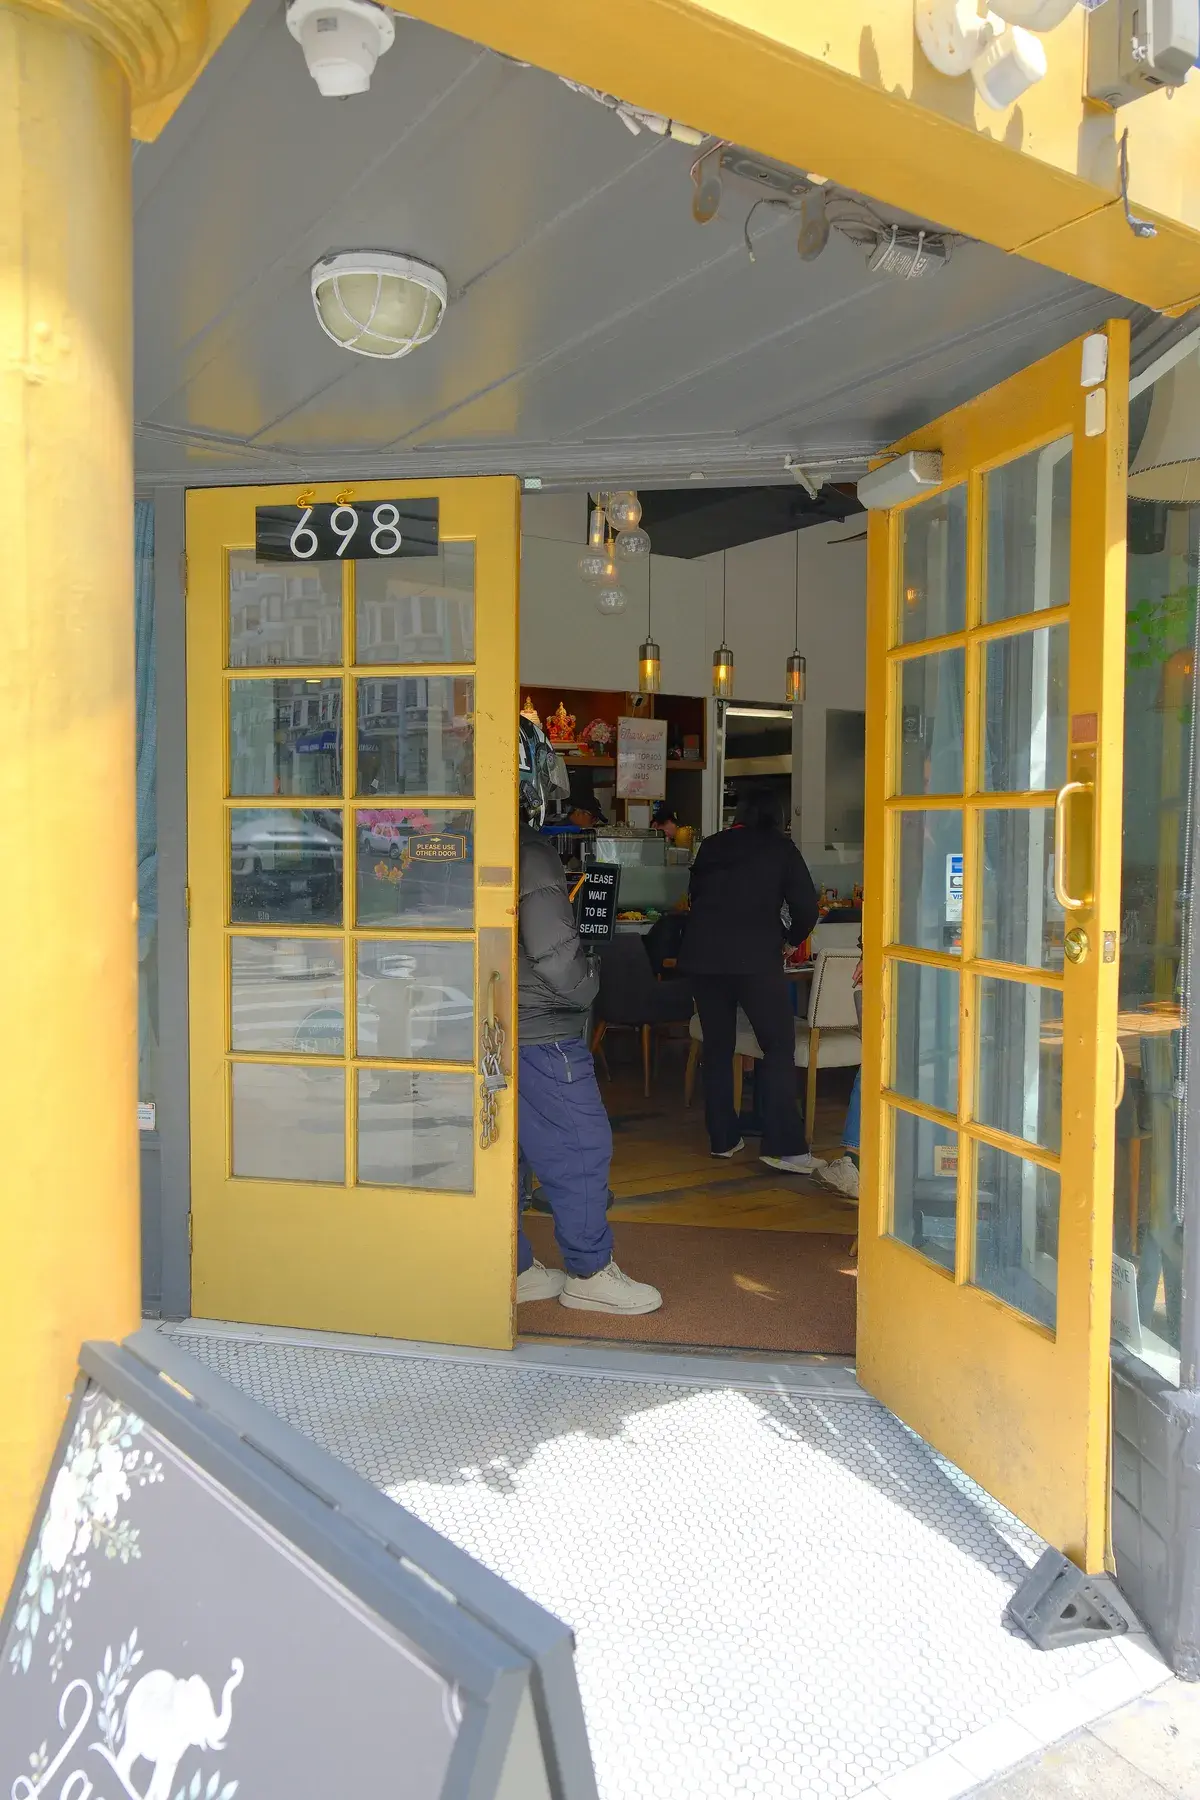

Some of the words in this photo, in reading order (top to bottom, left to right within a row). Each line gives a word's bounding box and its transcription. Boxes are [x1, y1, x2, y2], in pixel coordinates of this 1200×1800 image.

[290, 503, 402, 559] 698
[585, 873, 613, 884] PLEASE
[588, 890, 607, 901] WAIT
[585, 907, 595, 916] TO
[596, 908, 608, 917] BE
[579, 923, 609, 934] SEATED
